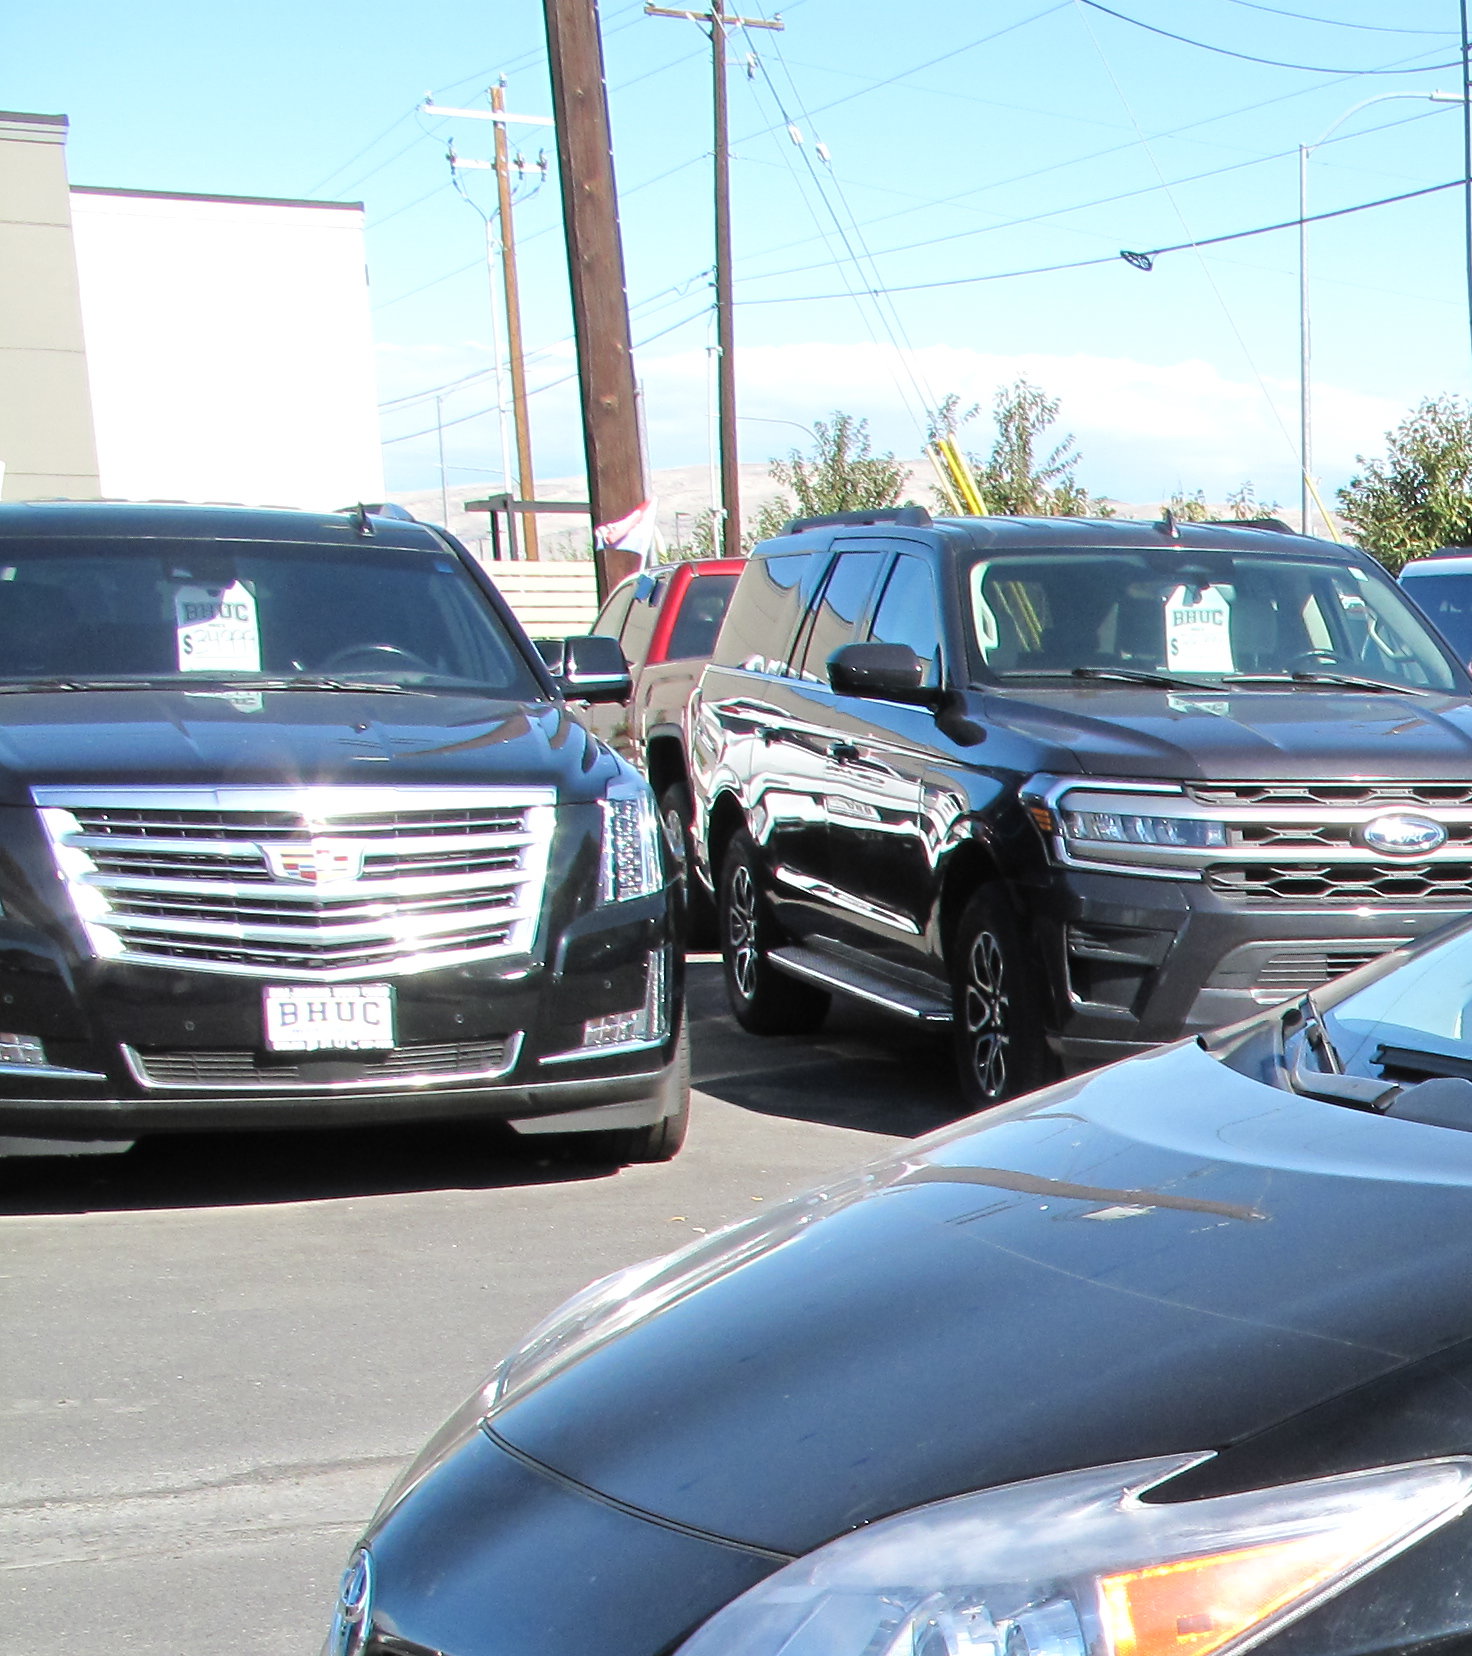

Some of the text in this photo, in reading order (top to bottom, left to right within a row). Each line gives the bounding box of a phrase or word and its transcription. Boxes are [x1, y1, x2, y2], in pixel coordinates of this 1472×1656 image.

[183, 602, 249, 622] BHUC
[1172, 609, 1224, 627] BHUC
[278, 1001, 381, 1027] BHUC
